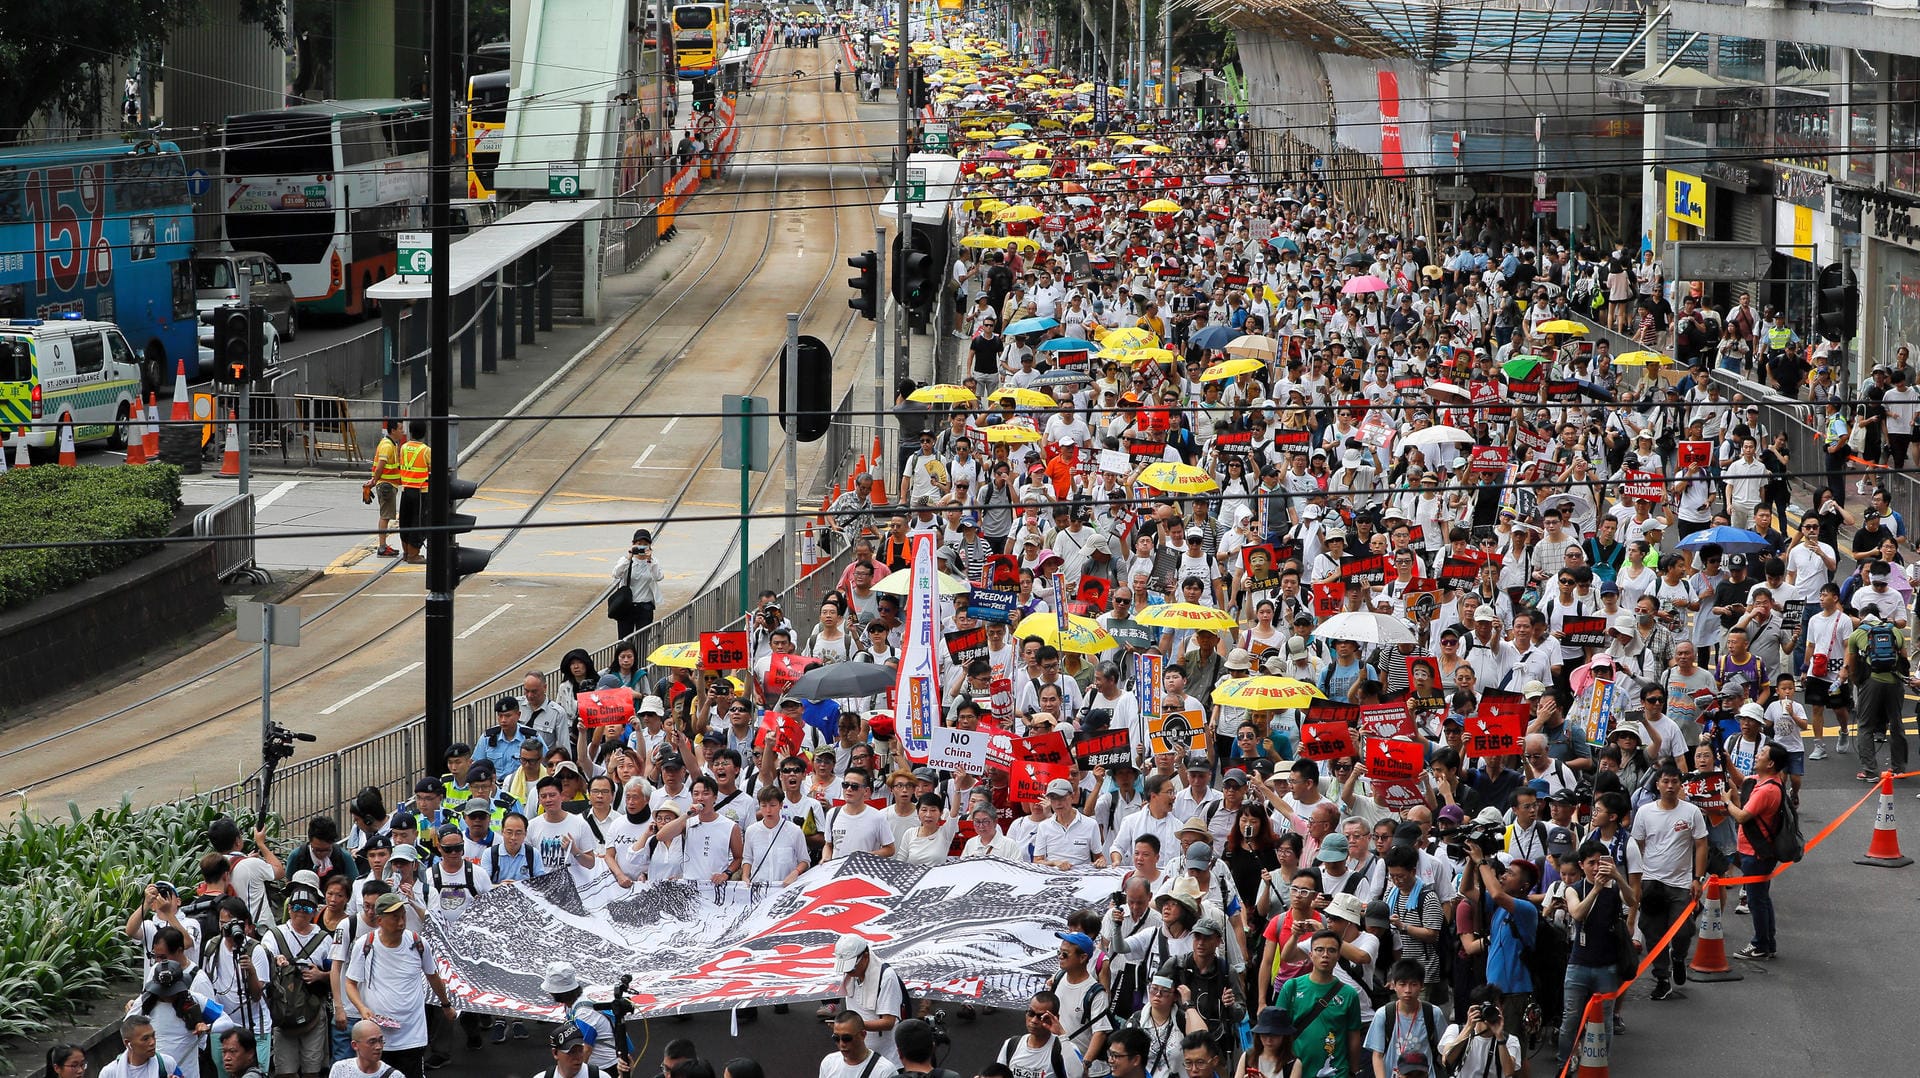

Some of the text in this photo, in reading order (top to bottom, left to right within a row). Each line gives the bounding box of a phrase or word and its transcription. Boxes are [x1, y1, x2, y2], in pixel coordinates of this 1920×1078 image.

[25, 163, 113, 297] 15%
[164, 223, 180, 245] citi
[55, 378, 70, 388] JOHN
[70, 373, 100, 384] AMBULANCE
[1633, 472, 1652, 487] NO
[973, 590, 1013, 604] FREEDOM
[707, 650, 744, 665] 反送中
[585, 704, 625, 717] No China
[586, 714, 627, 726] Extradition
[950, 732, 970, 746] NO
[1474, 733, 1514, 751] 反送中
[944, 746, 972, 759] China
[1307, 739, 1346, 757] 反送中
[929, 757, 983, 773] extradition
[1088, 750, 1131, 766] 逃犯條例
[1373, 757, 1413, 771] No China
[1372, 767, 1412, 780] Extradition
[1017, 780, 1031, 790] No
